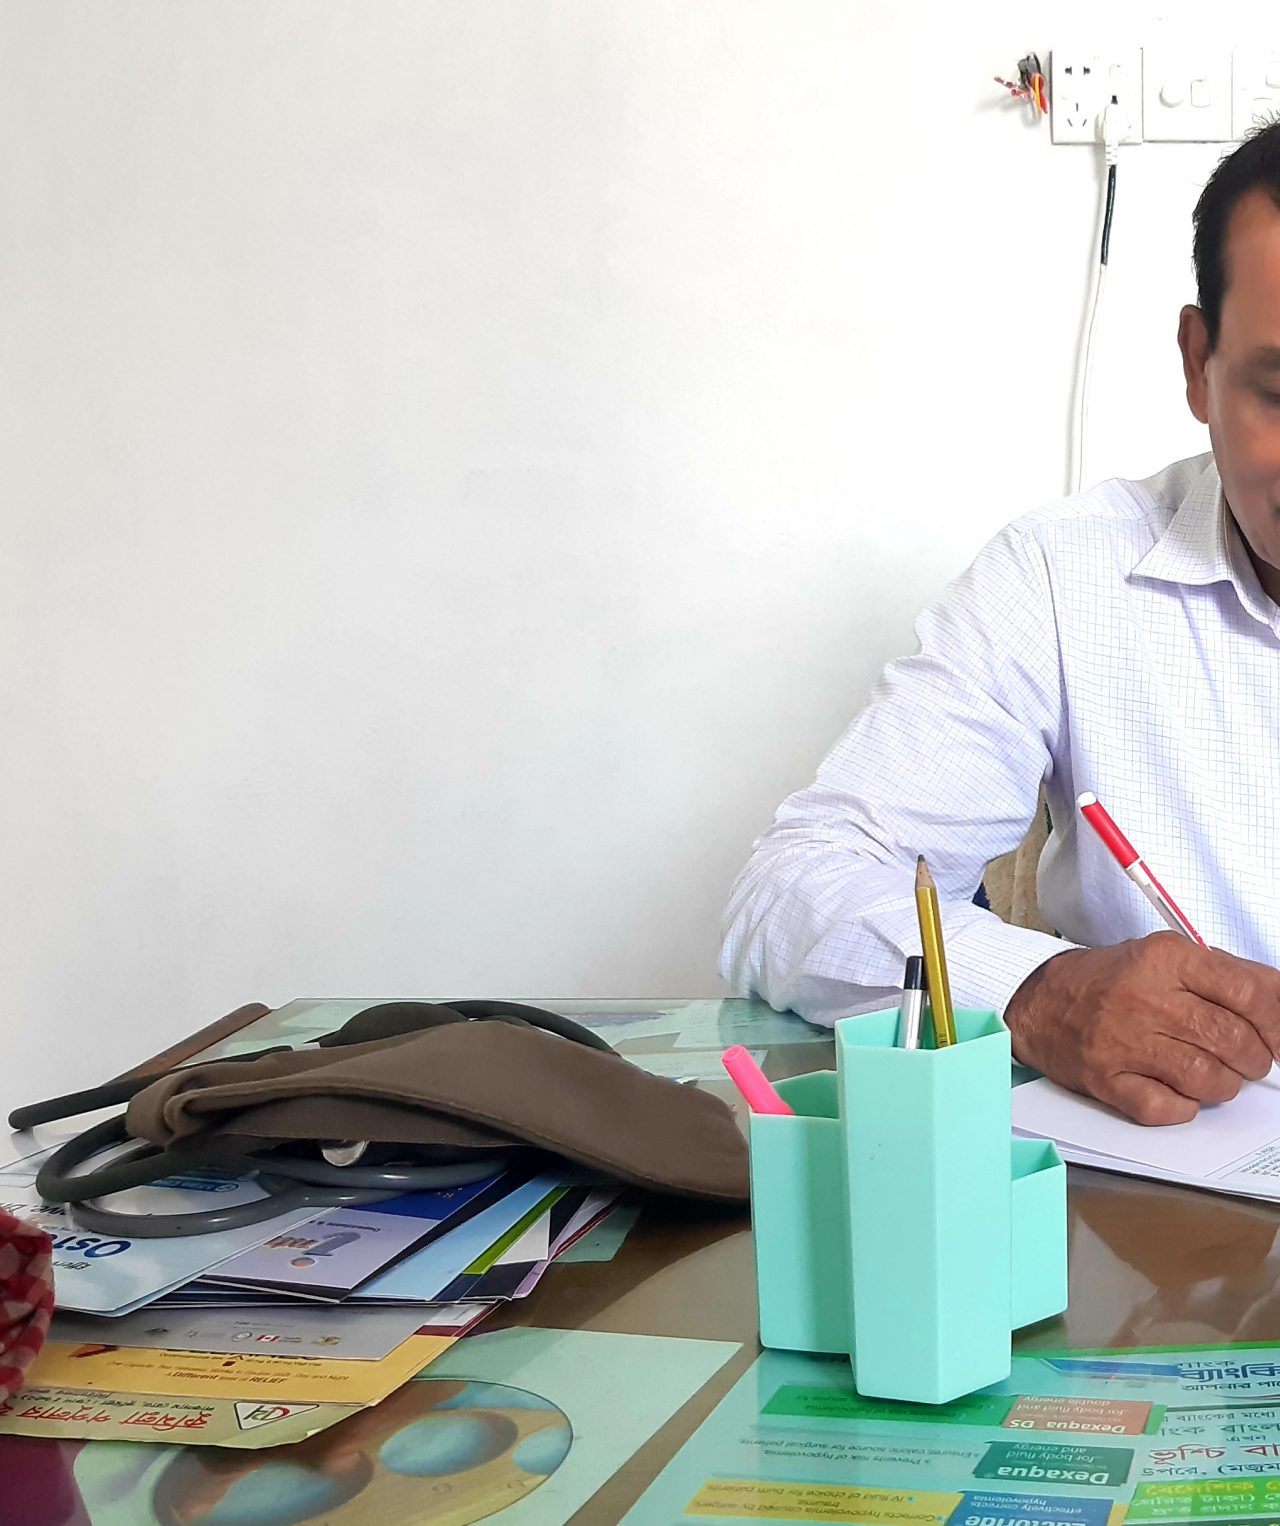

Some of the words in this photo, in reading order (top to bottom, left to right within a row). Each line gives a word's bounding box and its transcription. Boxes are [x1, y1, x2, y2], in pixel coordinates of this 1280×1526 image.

[1009, 1419, 1035, 1429] DS
[1047, 1420, 1126, 1434] Dexaqua
[997, 1466, 1110, 1485] Dexaqua
